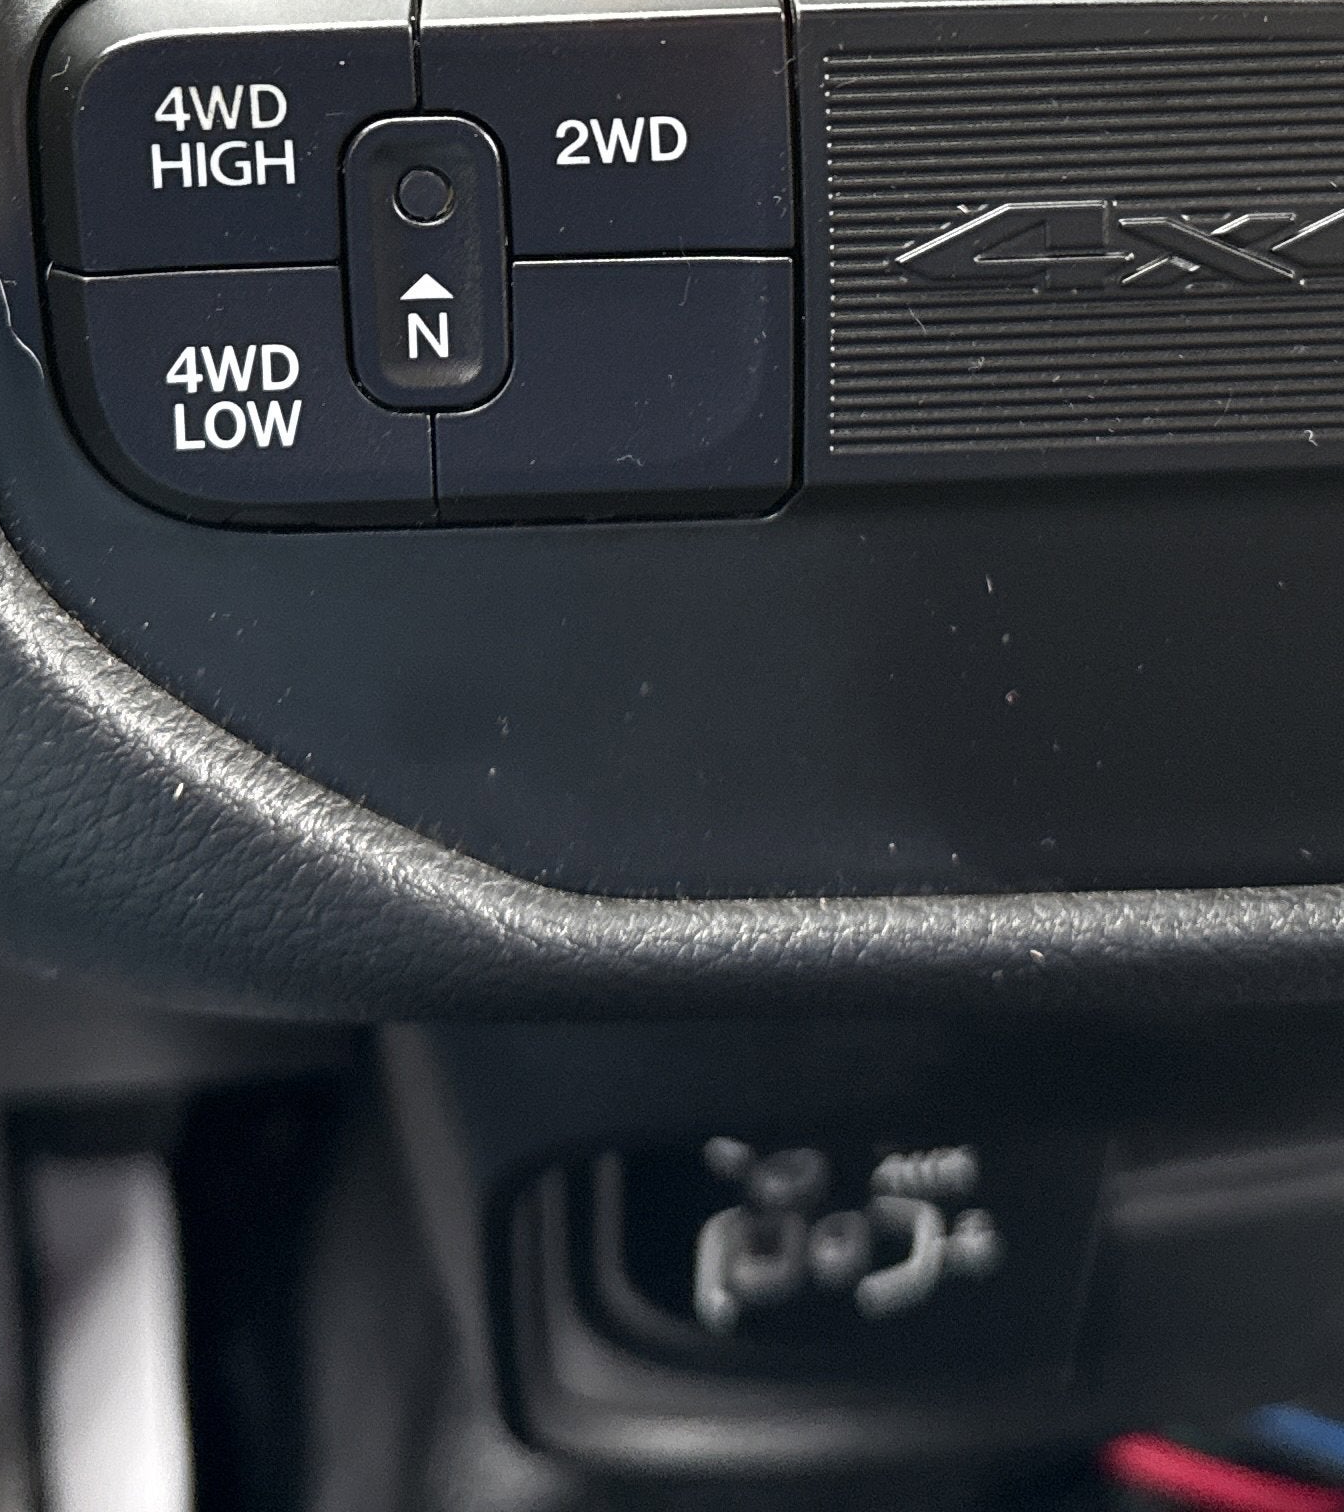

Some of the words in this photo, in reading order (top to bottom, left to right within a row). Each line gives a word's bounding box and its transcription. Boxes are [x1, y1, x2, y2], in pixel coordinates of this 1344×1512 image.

[154, 83, 287, 132] 4WD
[151, 139, 296, 190] HIGH
[555, 115, 688, 165] 2WD
[407, 311, 449, 359] N
[165, 343, 300, 394] 4WD
[173, 399, 303, 451] LOW
